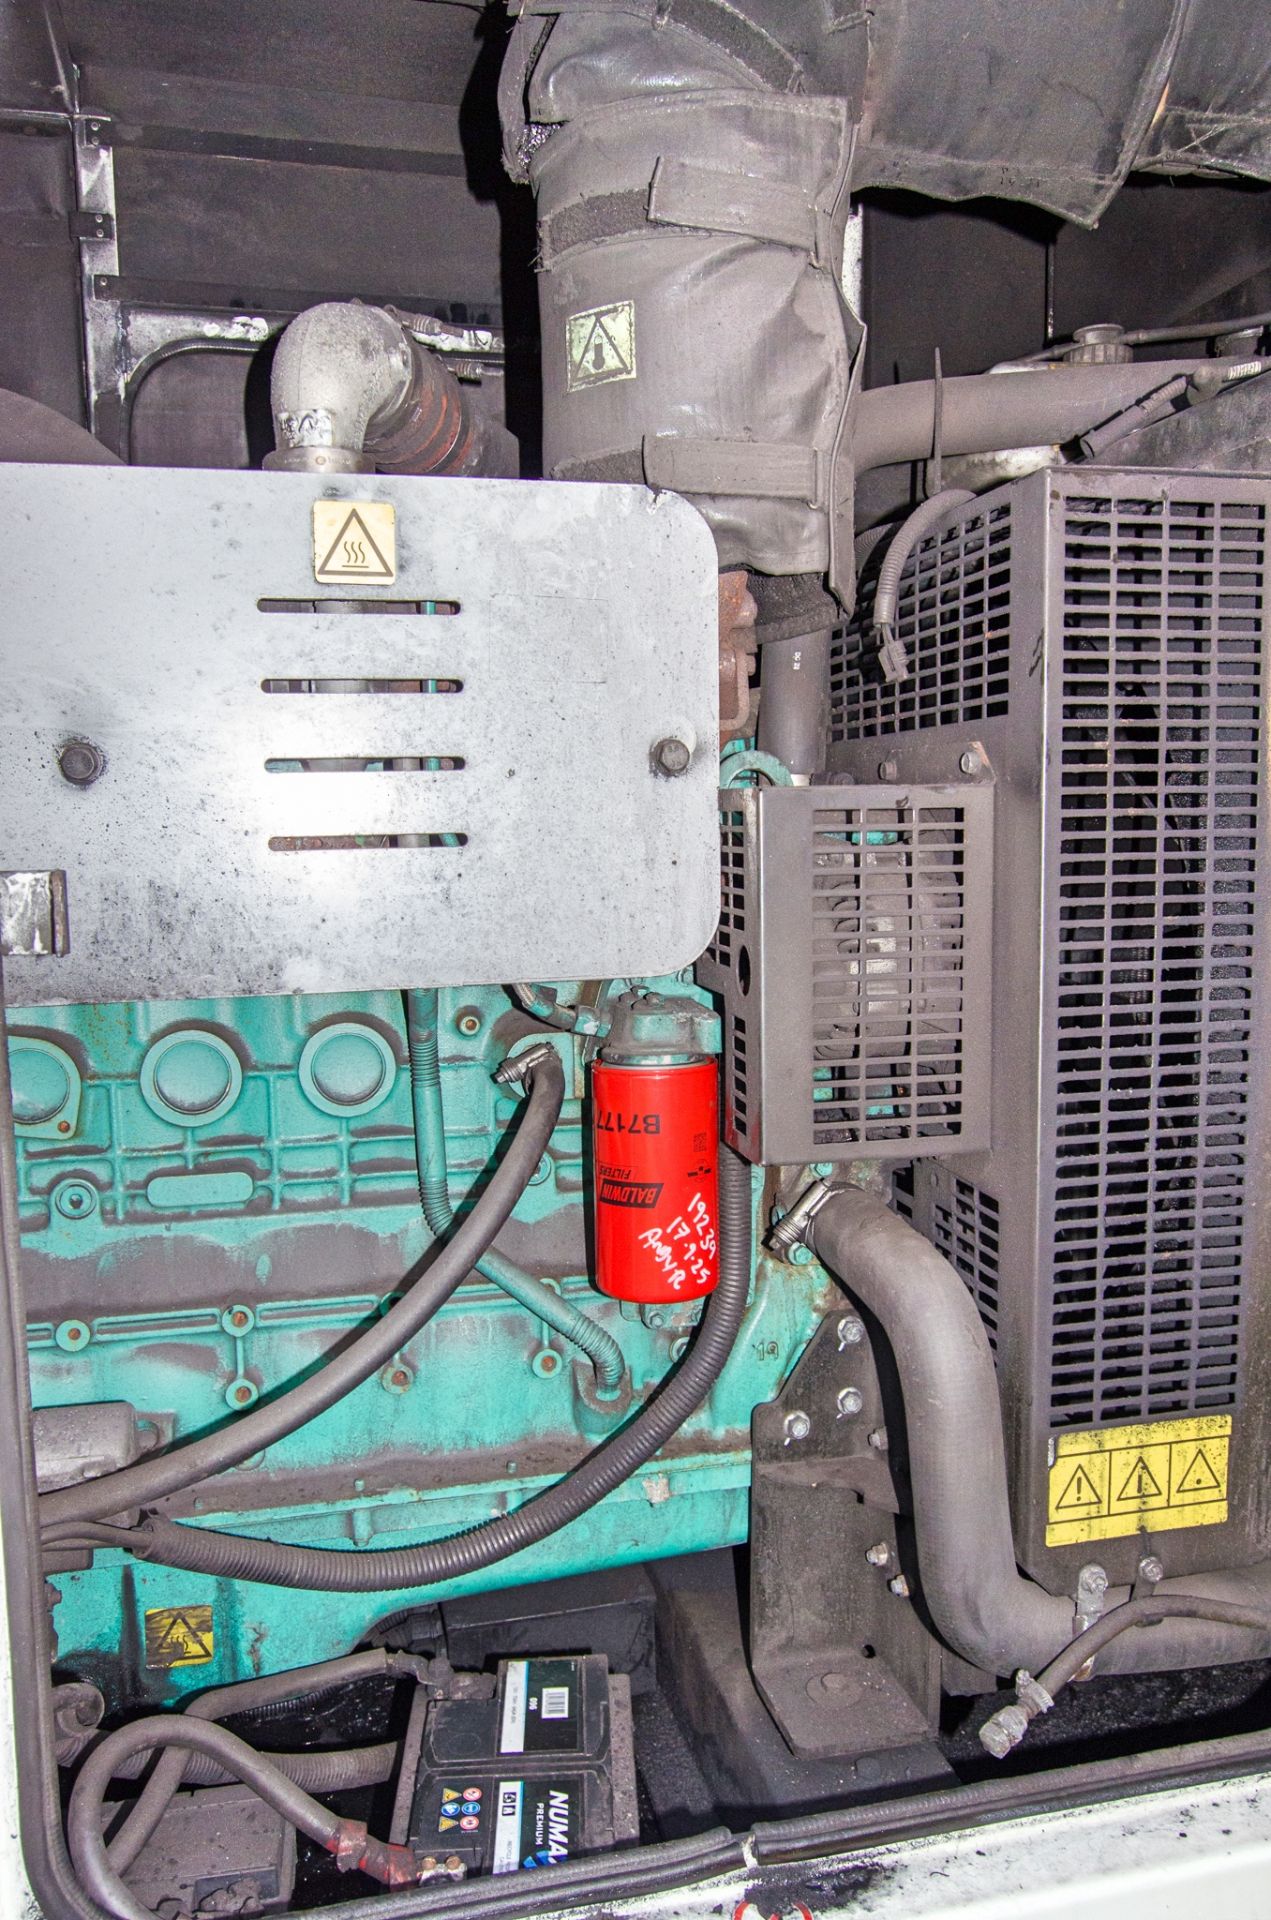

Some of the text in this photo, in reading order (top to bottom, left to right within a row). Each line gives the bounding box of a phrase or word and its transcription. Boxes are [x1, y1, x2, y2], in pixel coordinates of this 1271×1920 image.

[597, 1111, 661, 1134] B7177
[602, 1183, 658, 1204] BALDWIN
[535, 1803, 545, 1846] PREMIUM
